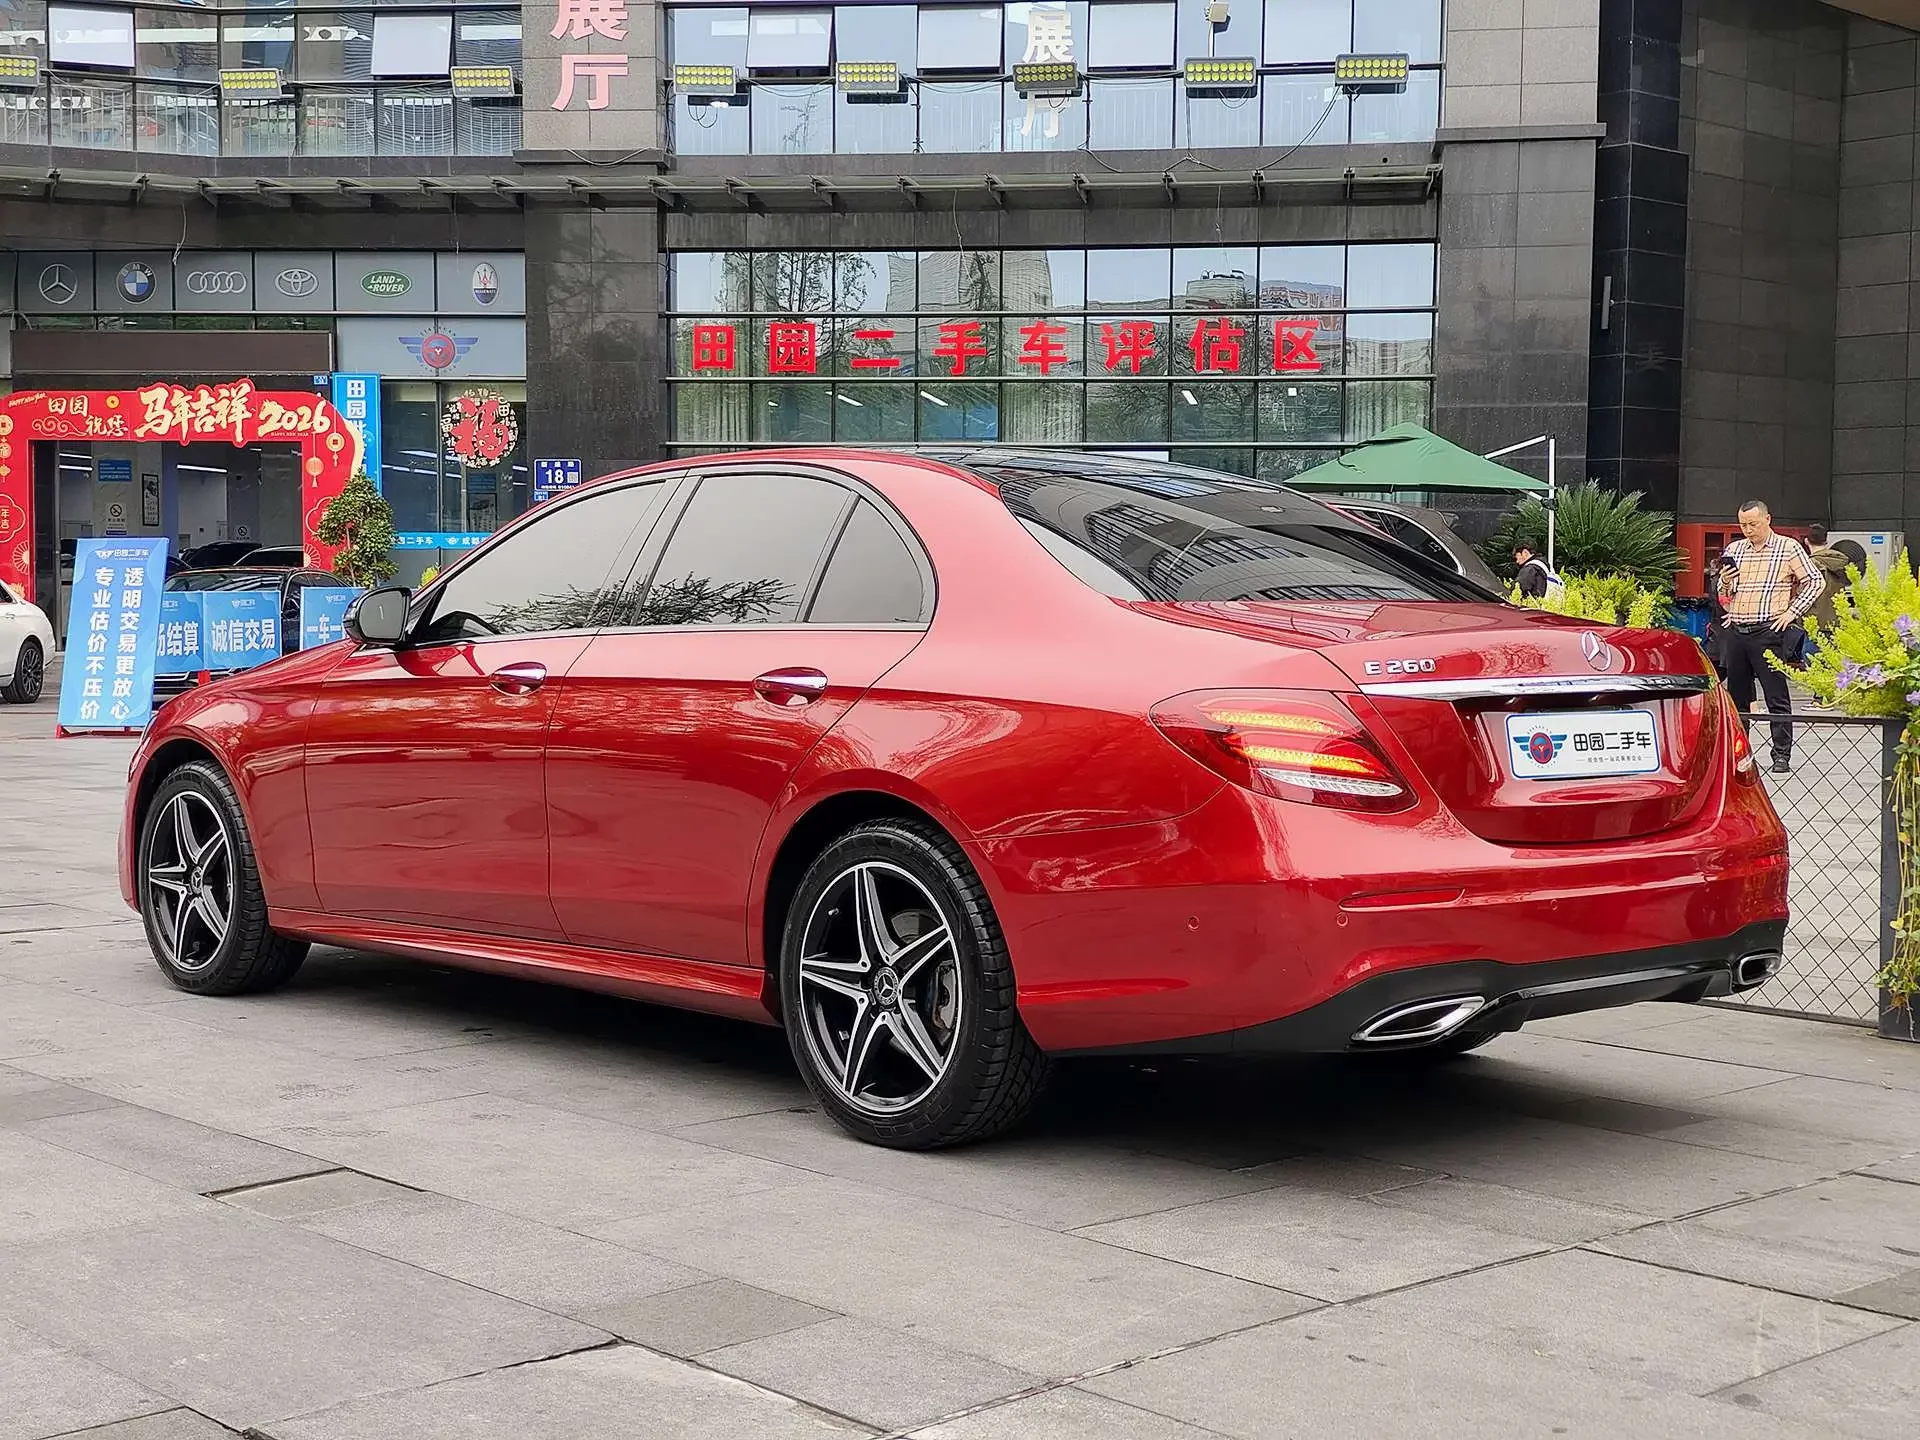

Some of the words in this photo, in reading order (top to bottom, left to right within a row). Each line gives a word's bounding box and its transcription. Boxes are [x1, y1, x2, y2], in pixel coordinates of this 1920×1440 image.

[550, 0, 628, 111] 展厅
[371, 275, 395, 283] LAND
[693, 317, 1322, 376] 田园二手车评估区
[48, 395, 88, 417] 田园
[134, 383, 252, 442] 马年吉祥
[257, 399, 331, 438] 2026
[85, 414, 128, 437] 祝您
[545, 469, 564, 484] 18
[81, 567, 115, 720] 专业估价不压价
[110, 567, 144, 720] 透明交易更放心
[211, 618, 275, 652] 诚信交易
[307, 614, 347, 643] 一车一
[1364, 661, 1382, 675] E
[1386, 659, 1436, 674] 260
[1573, 731, 1652, 751] 田园二手车
